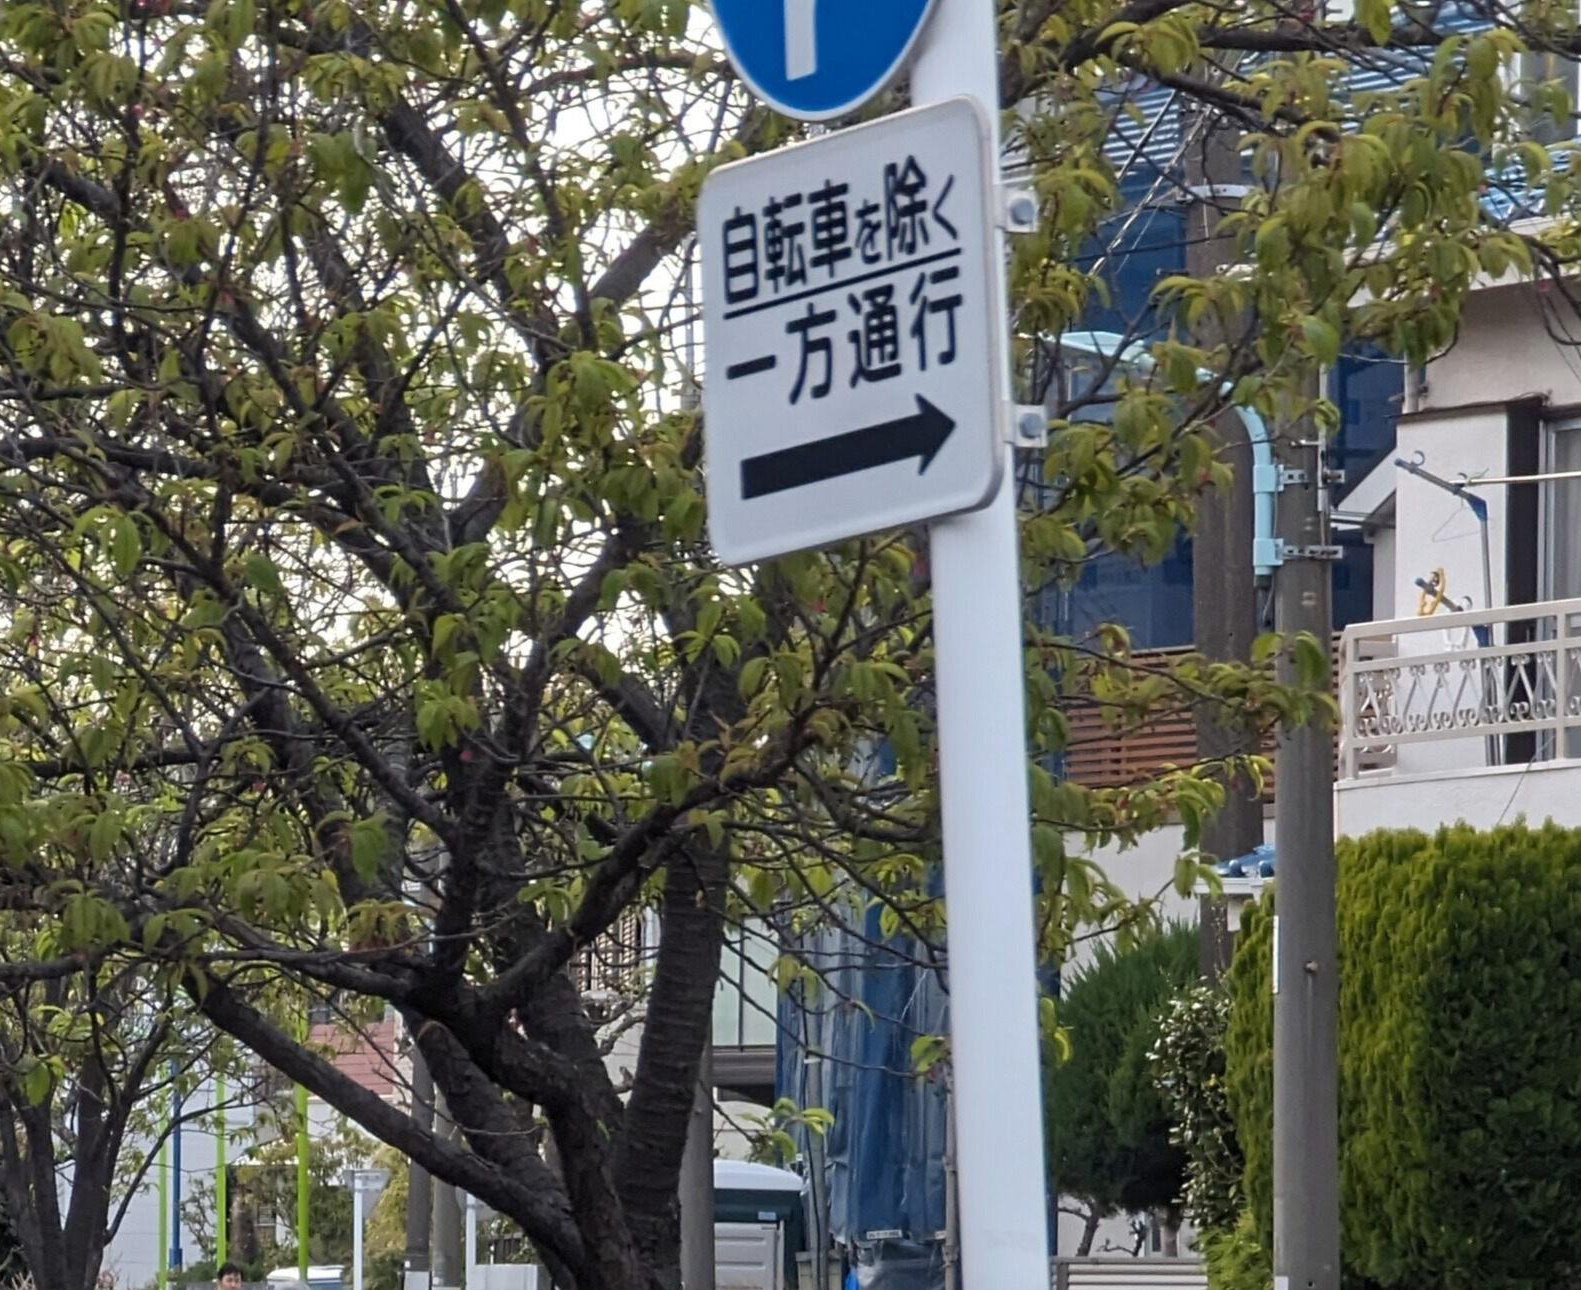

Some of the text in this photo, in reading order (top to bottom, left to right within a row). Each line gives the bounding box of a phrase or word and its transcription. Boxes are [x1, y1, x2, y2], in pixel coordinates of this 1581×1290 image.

[722, 155, 958, 304] 自転車を除く
[725, 266, 963, 405] 一方通行
